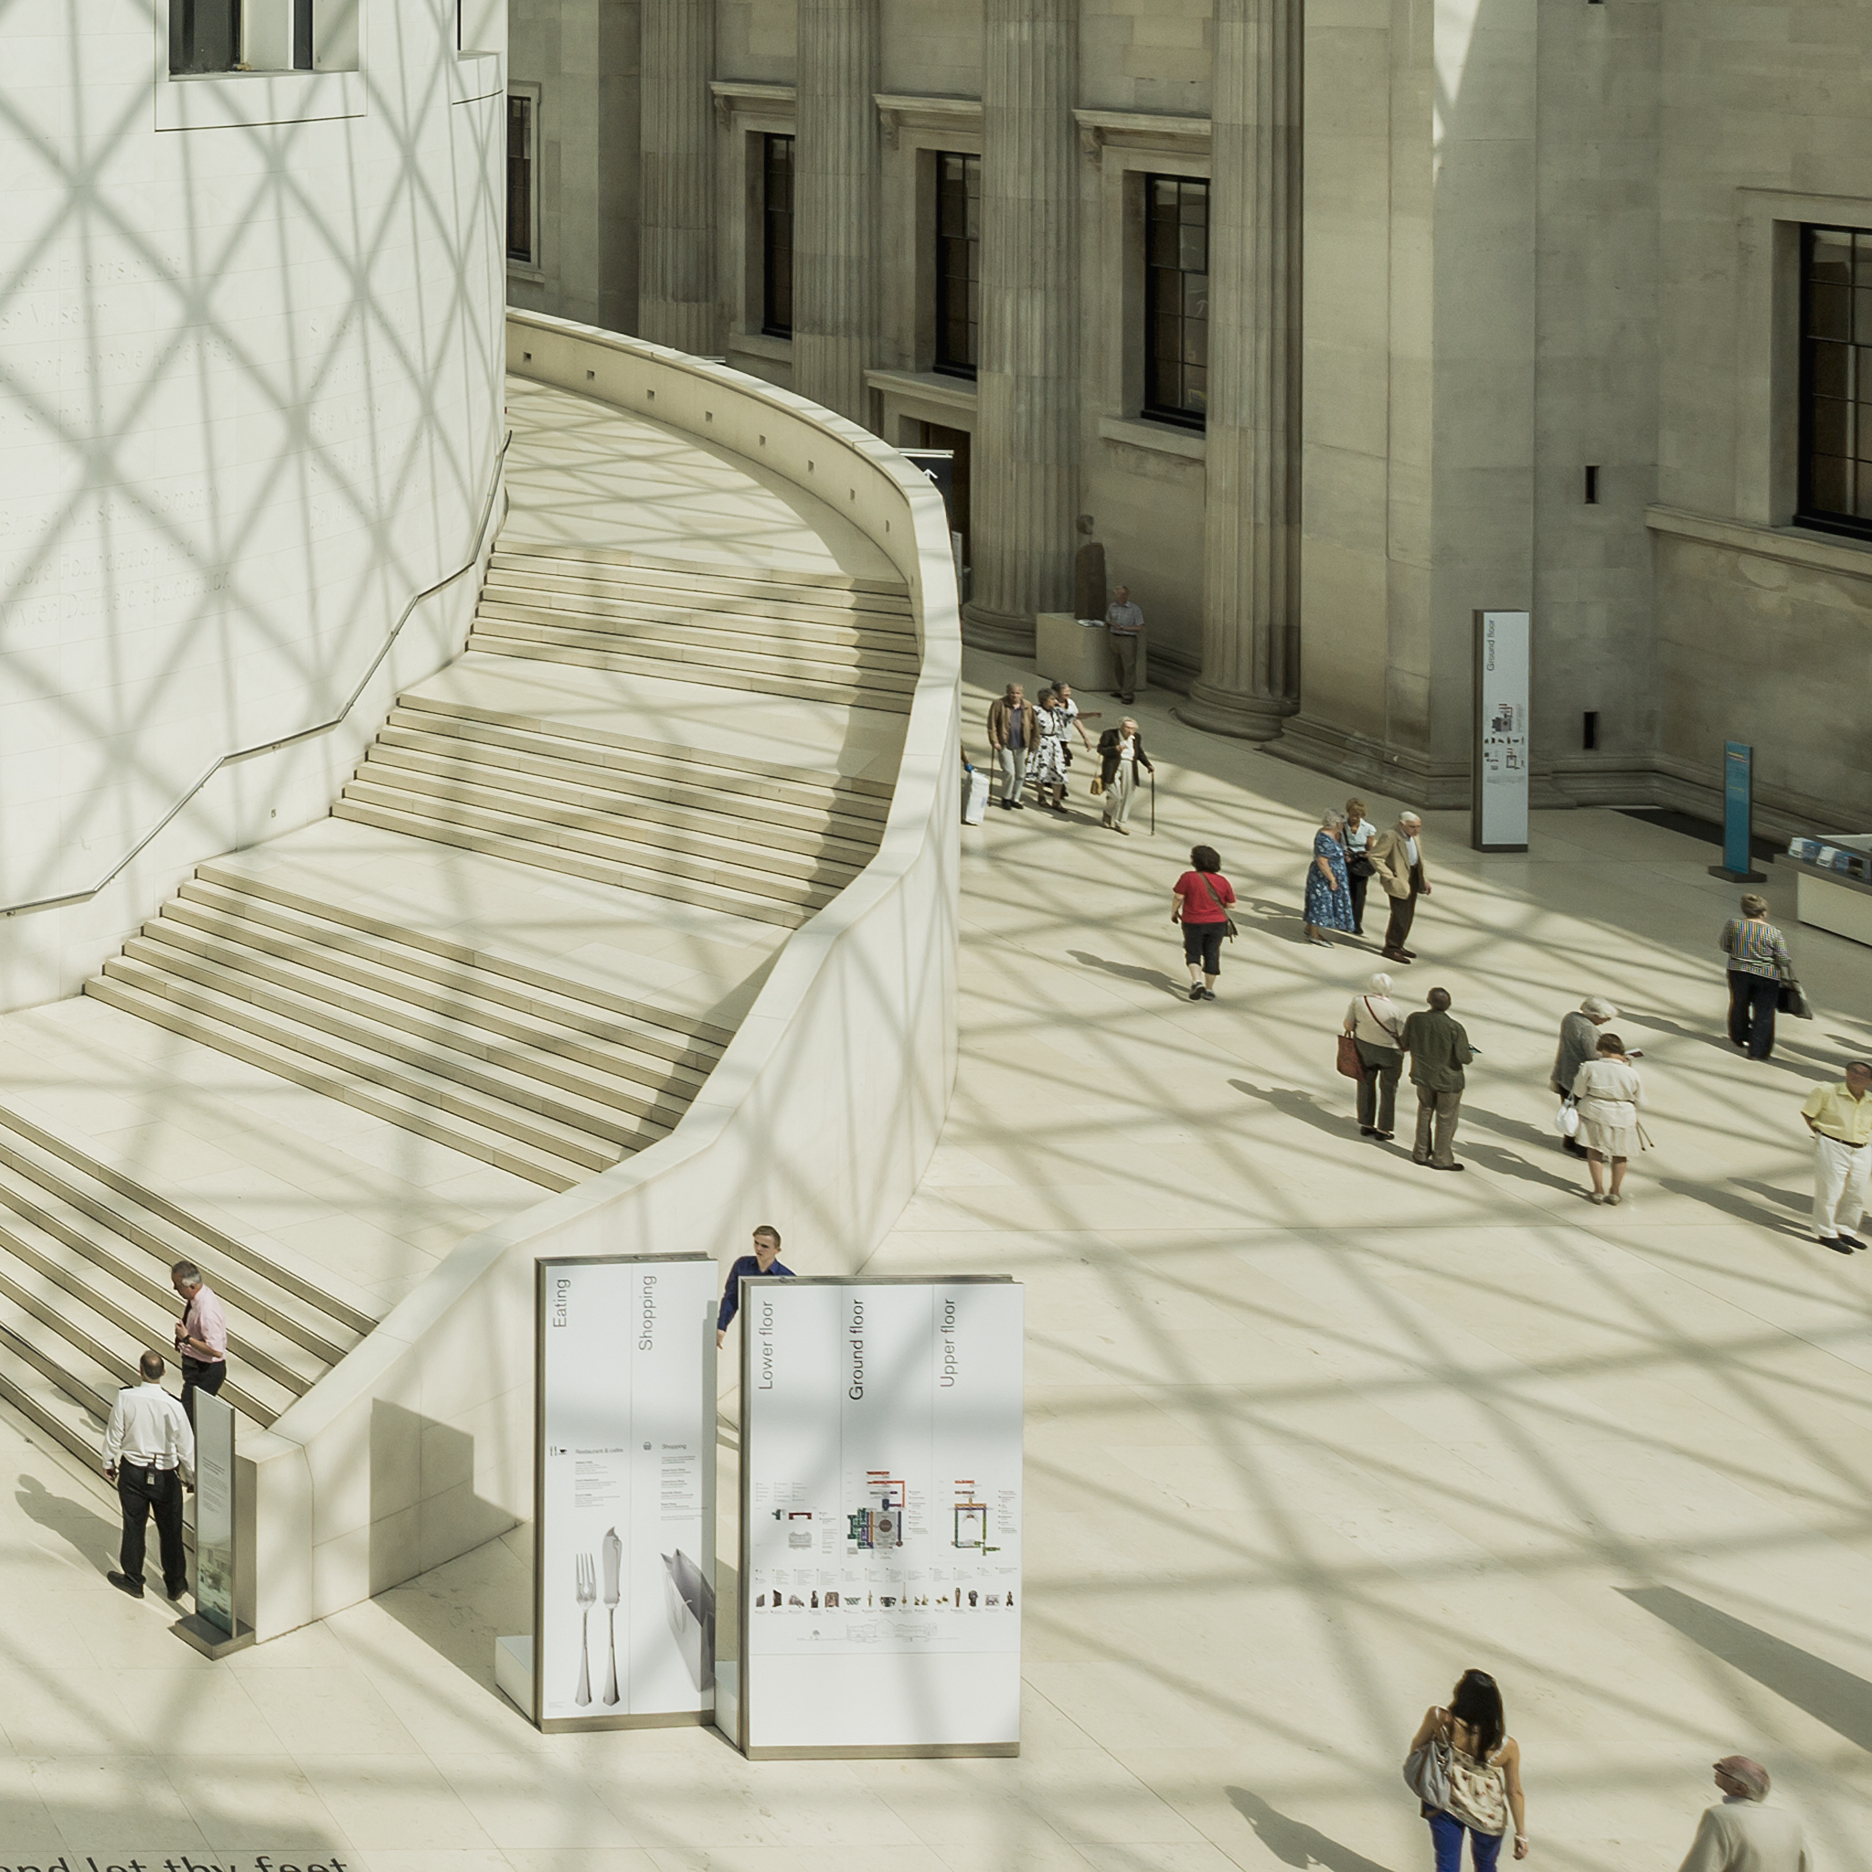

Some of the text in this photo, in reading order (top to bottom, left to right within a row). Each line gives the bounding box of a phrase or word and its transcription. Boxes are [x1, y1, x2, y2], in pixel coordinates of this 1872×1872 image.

[1487, 639, 1495, 672] Ground
[553, 1279, 571, 1328] Eating
[638, 1275, 658, 1351] Shopping
[758, 1300, 773, 1390] Lower floor
[940, 1298, 959, 1388] Upper floor
[848, 1299, 864, 1401] Ground floor
